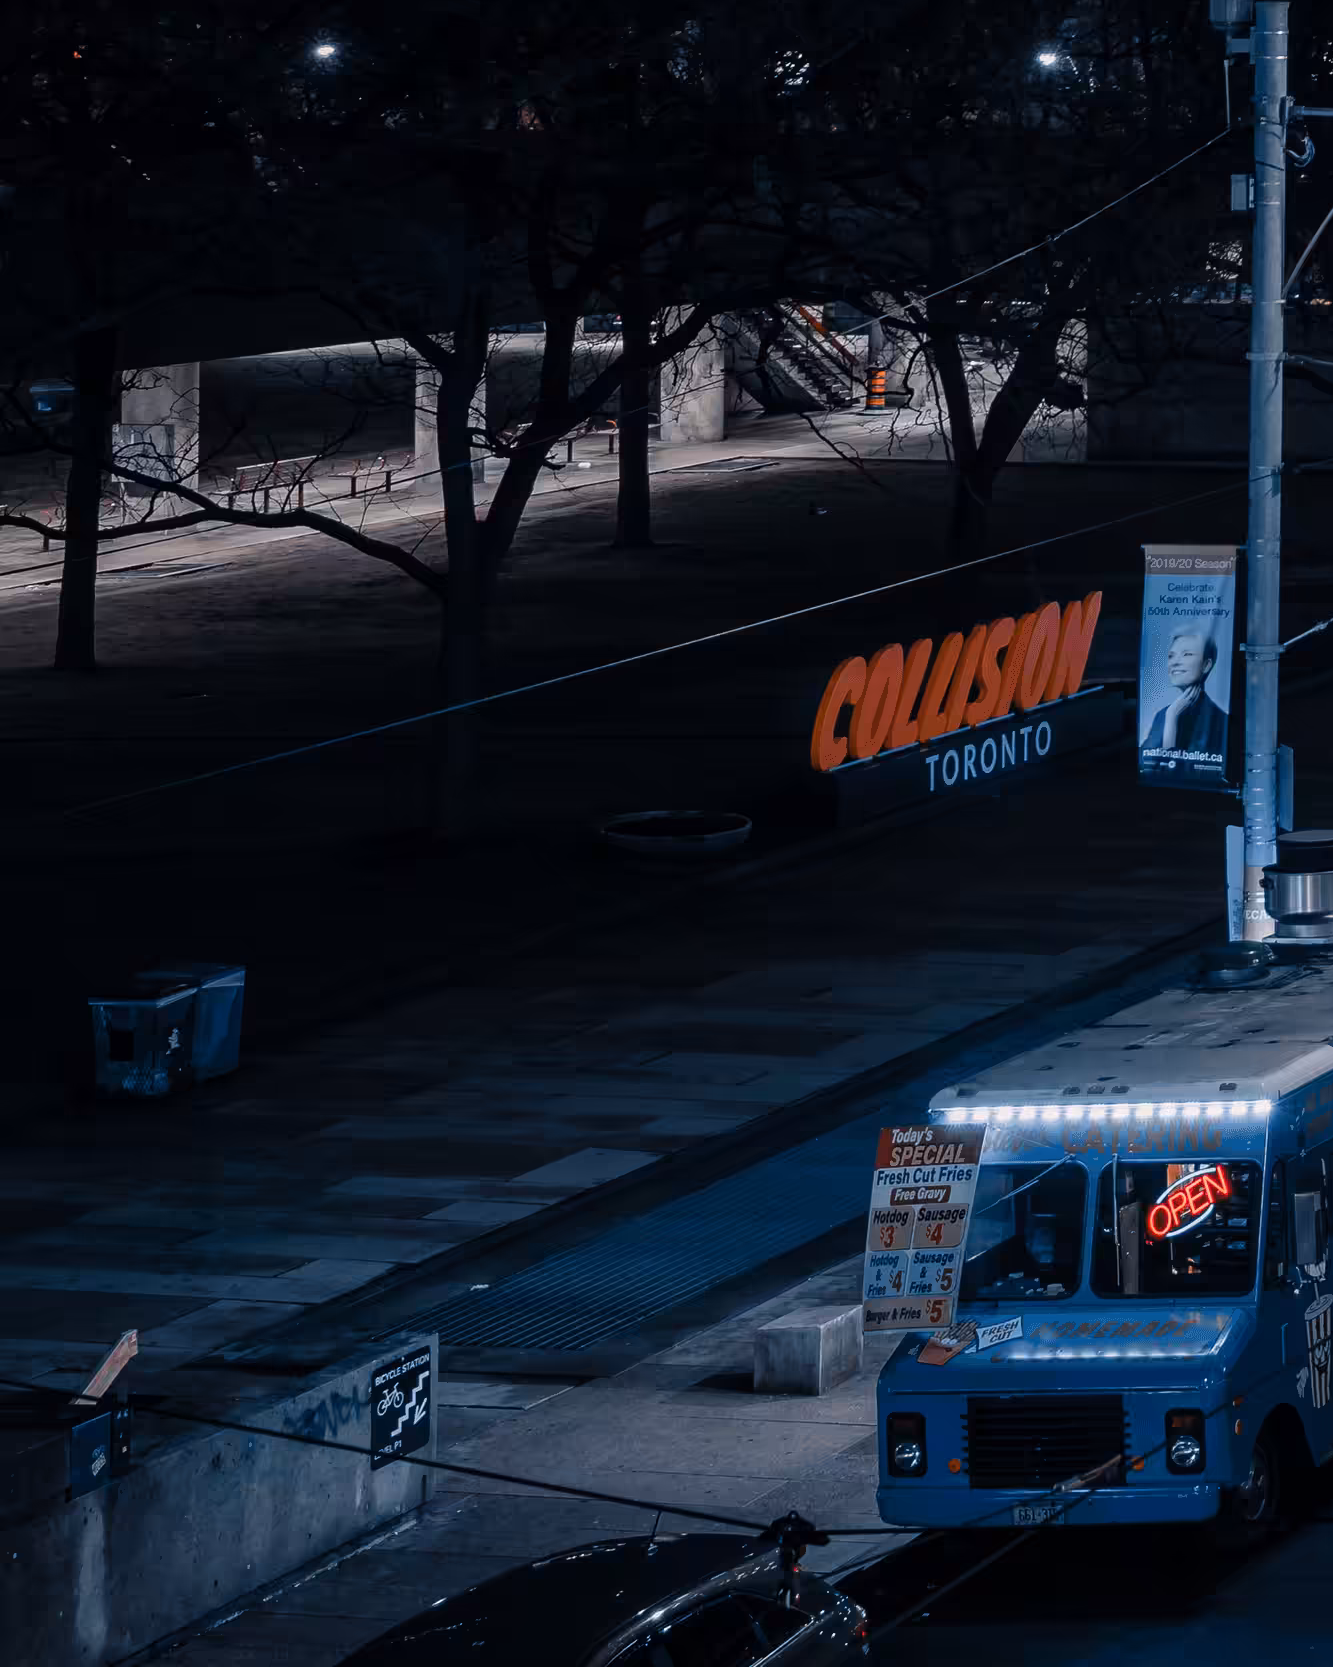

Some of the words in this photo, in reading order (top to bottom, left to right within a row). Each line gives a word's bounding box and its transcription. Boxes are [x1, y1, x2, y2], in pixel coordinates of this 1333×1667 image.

[1150, 557, 1193, 569] 2019/20
[1194, 558, 1232, 569] Season
[1168, 583, 1214, 592] Celebrate
[1159, 595, 1188, 604] Karen
[1192, 595, 1222, 604] Kain's
[1148, 607, 1170, 616] 50th
[1173, 607, 1230, 618] Anniversary
[811, 591, 1102, 772] COLLISION
[926, 721, 1051, 792] TORONTO
[892, 1127, 933, 1145] Today's
[1062, 1117, 1223, 1154] CATERING
[890, 1144, 966, 1167] SPECIAL
[877, 1169, 910, 1186] Fresh
[913, 1168, 936, 1184] Cut
[938, 1166, 973, 1182] Fries
[894, 1188, 915, 1201] Free
[917, 1186, 946, 1202] Gravy
[1150, 1165, 1228, 1235] OPEN
[873, 1209, 909, 1226] Hotdog
[918, 1207, 966, 1223] Sausage
[880, 1226, 896, 1248] $3
[925, 1223, 944, 1245] $4
[870, 1253, 899, 1268] Hotdog
[913, 1250, 954, 1266] Sausage
[875, 1268, 883, 1281] &
[889, 1270, 903, 1293] $4
[920, 1267, 927, 1279] &
[935, 1268, 953, 1292] $5
[867, 1283, 886, 1297] Fries
[909, 1281, 932, 1294] Fries
[901, 1307, 921, 1319] Fries
[925, 1299, 946, 1324] $5
[981, 1320, 1019, 1338] FRESH
[989, 1331, 1013, 1343] CUT
[1030, 1320, 1194, 1338] HOMEMADE
[375, 1367, 401, 1386] BICYCLE
[402, 1353, 430, 1373] STATION
